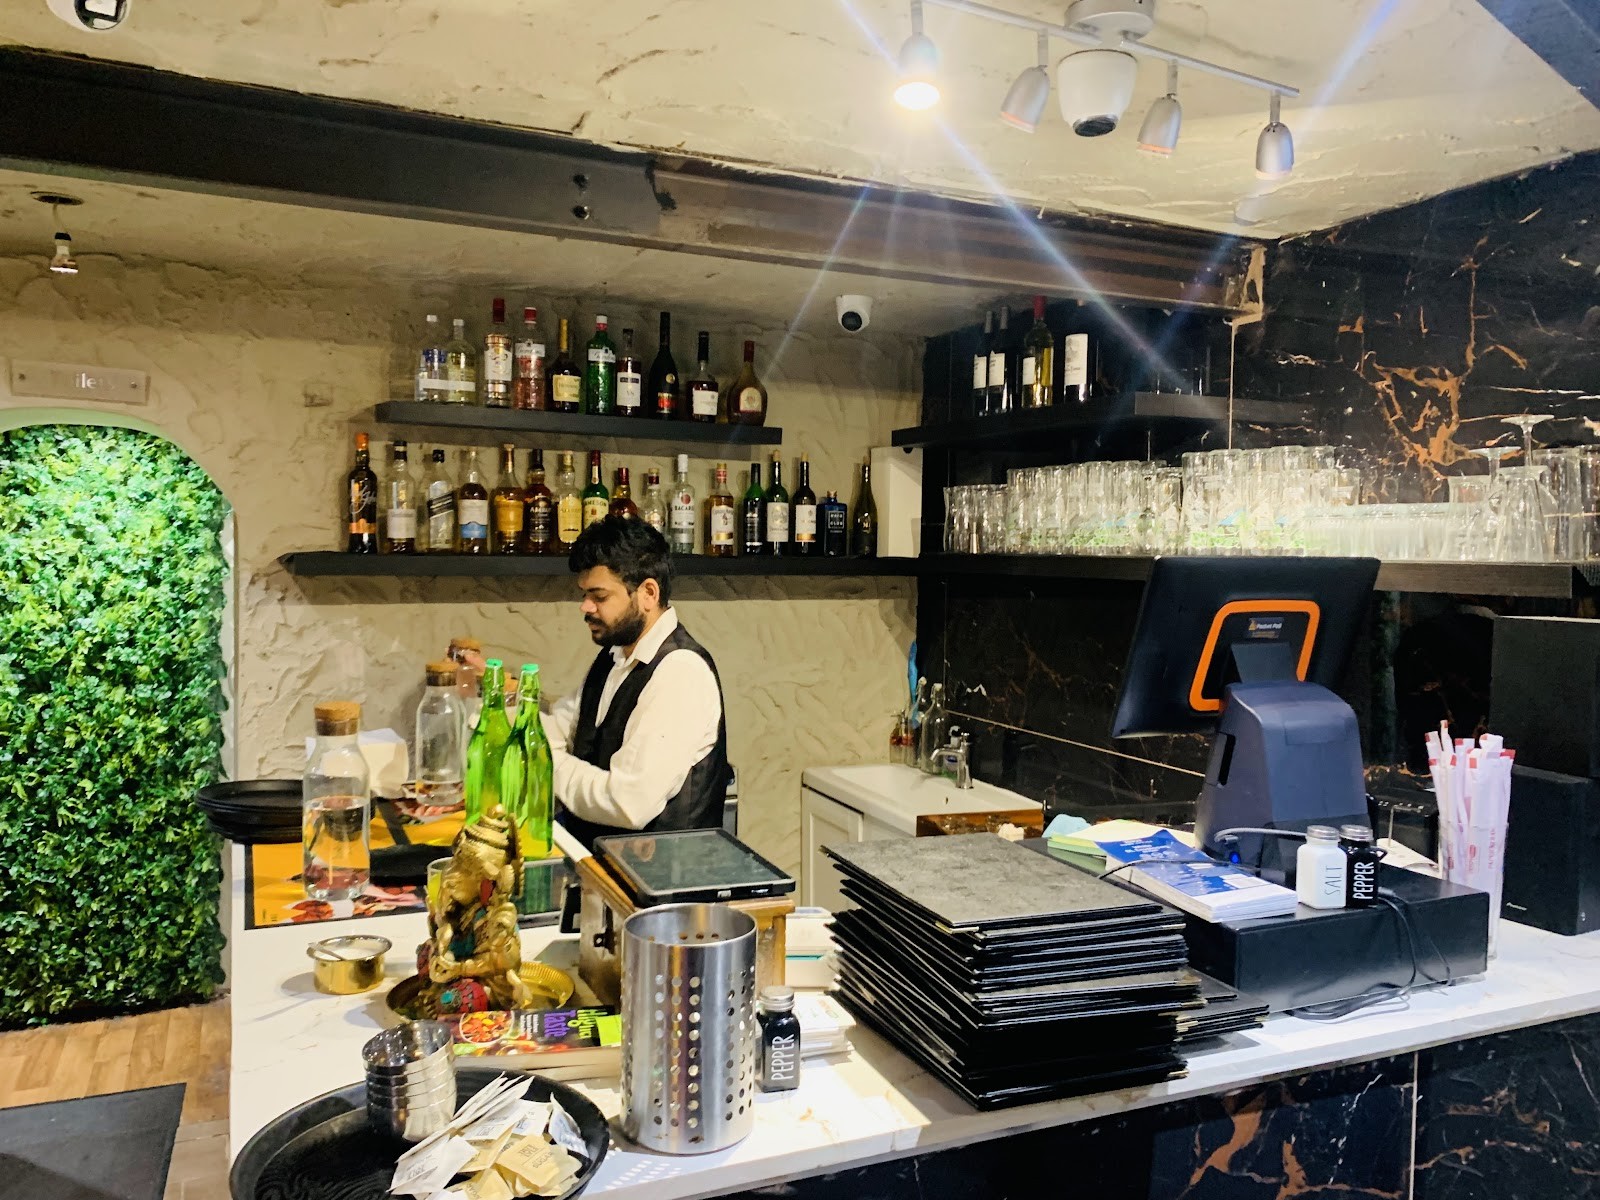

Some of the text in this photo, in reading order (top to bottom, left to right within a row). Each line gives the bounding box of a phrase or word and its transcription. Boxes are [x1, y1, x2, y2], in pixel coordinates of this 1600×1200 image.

[1324, 866, 1343, 896] SALT
[1352, 861, 1374, 899] PEPPER
[544, 1009, 576, 1038] Taste
[771, 1033, 795, 1080] PEPPER
